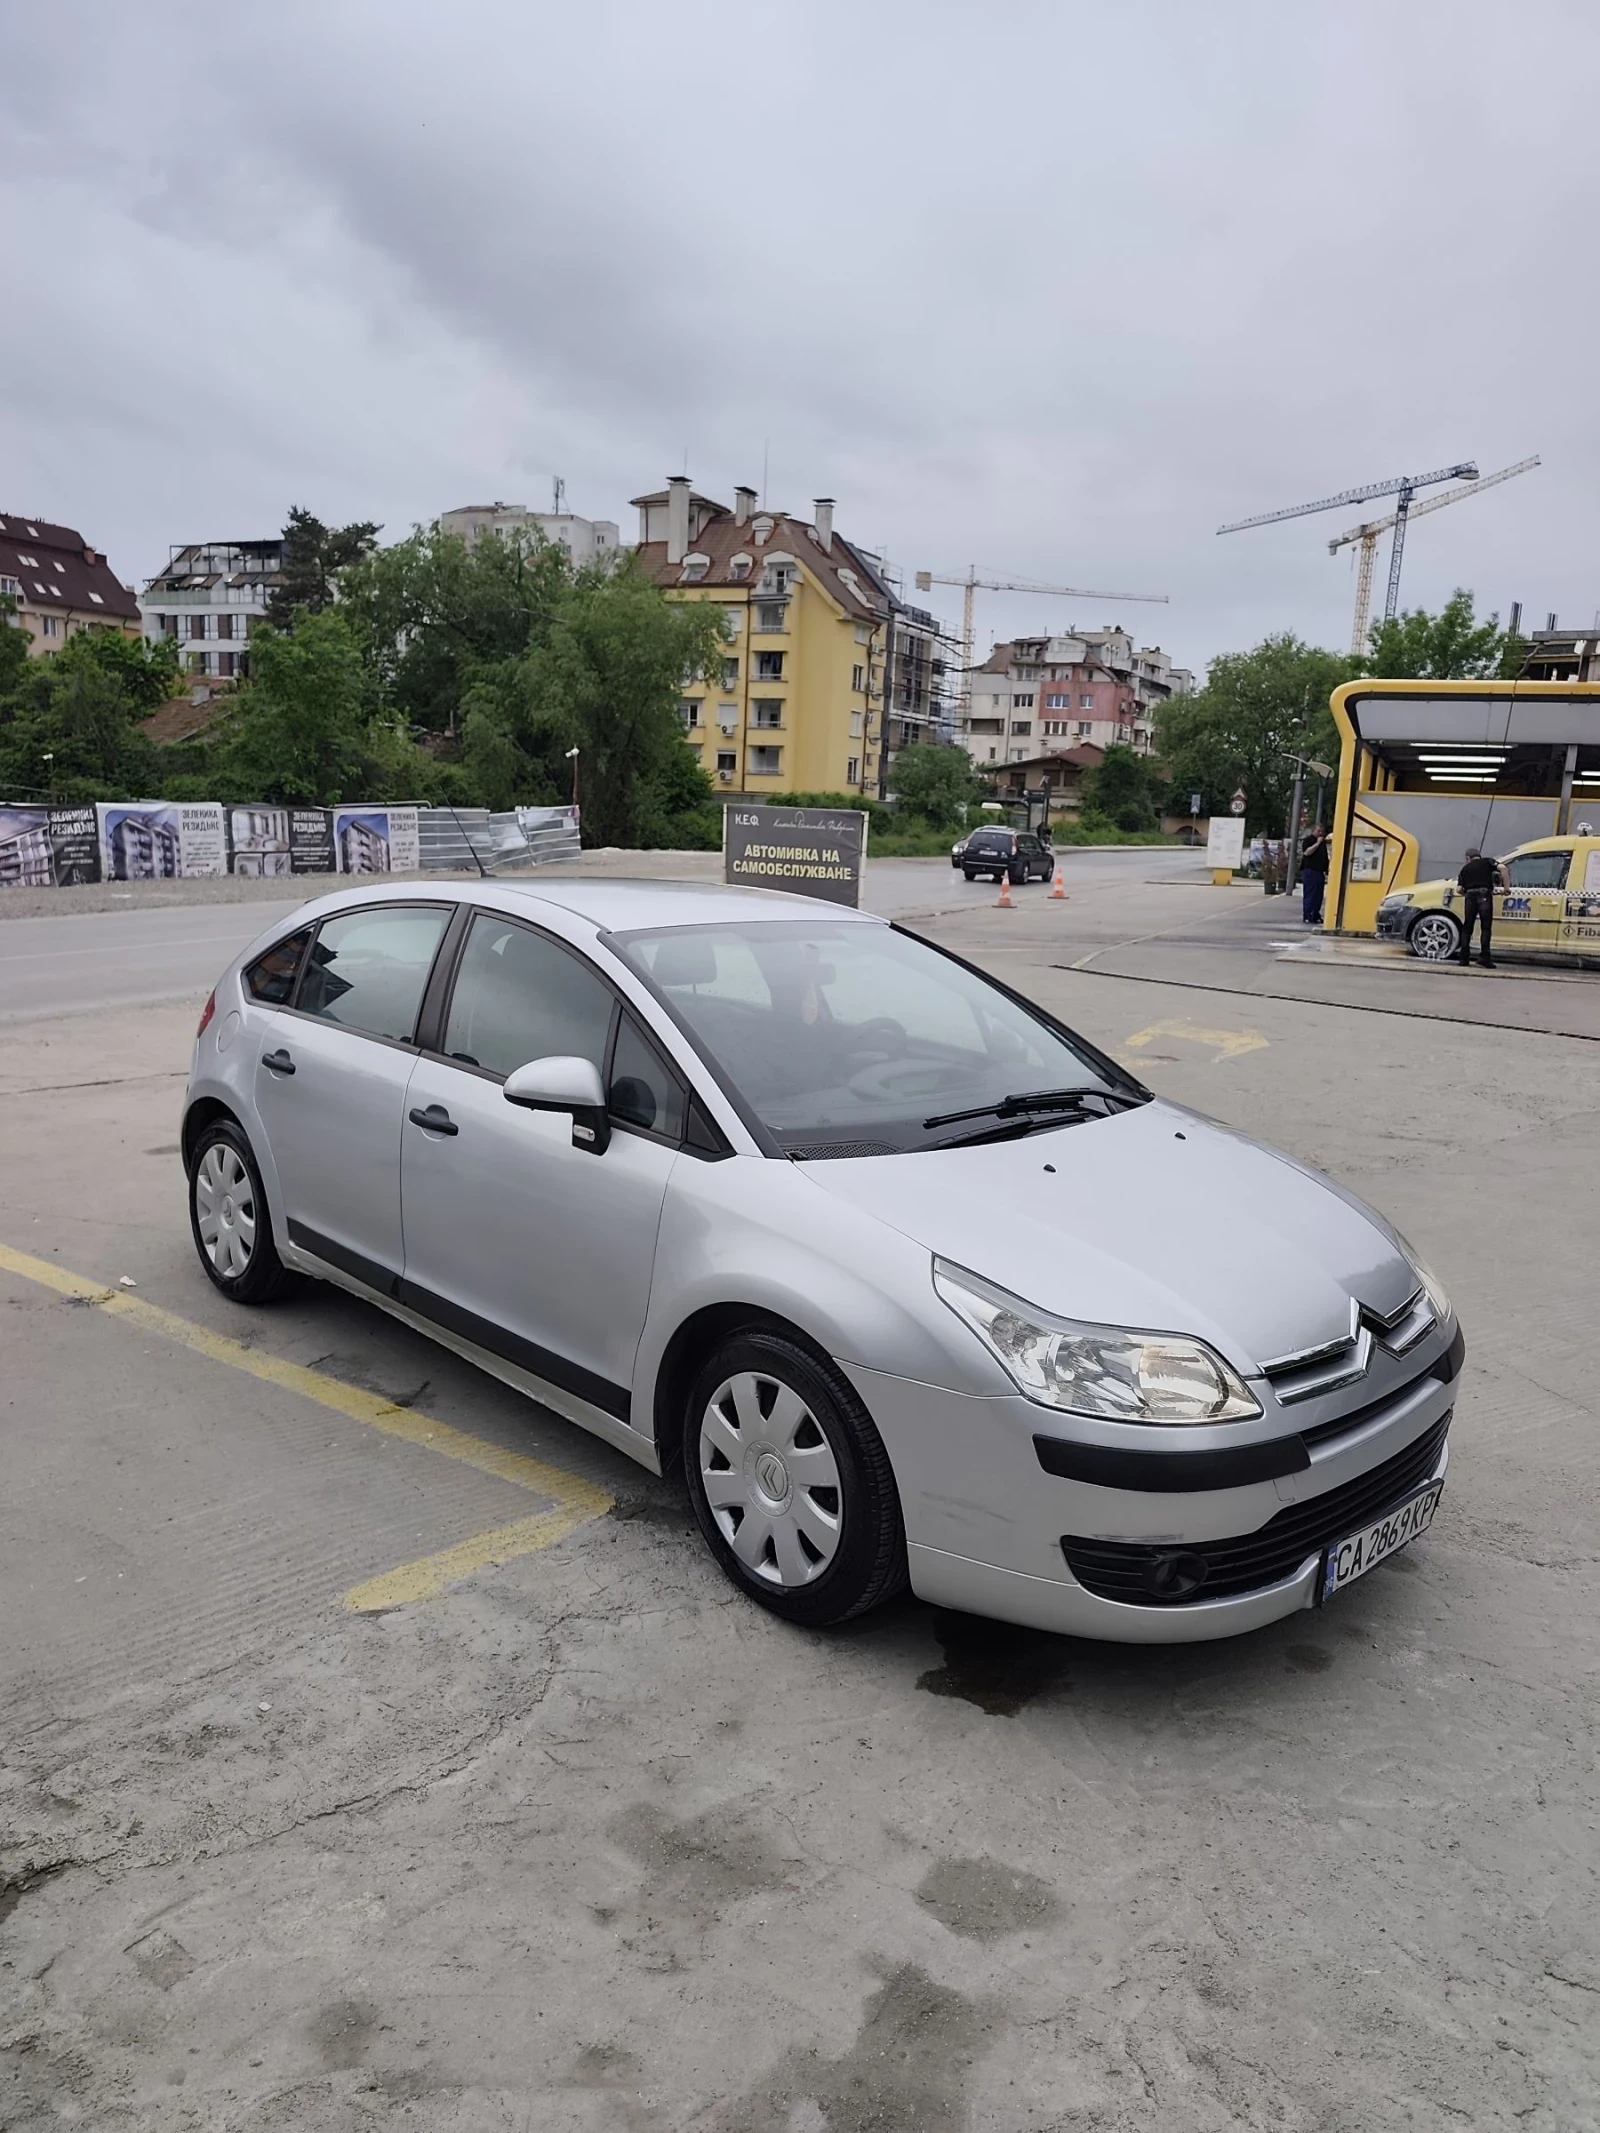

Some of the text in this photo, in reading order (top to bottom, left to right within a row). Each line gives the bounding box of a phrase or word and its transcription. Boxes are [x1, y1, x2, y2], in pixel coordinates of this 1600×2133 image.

[182, 809, 218, 819] ЗЕЛЕНИКА
[744, 844, 840, 862] АВТОМИВКА НА
[733, 860, 852, 880] САМООБСЛУЖВАНЕ
[1337, 1491, 1435, 1581] CA 2869 KP
